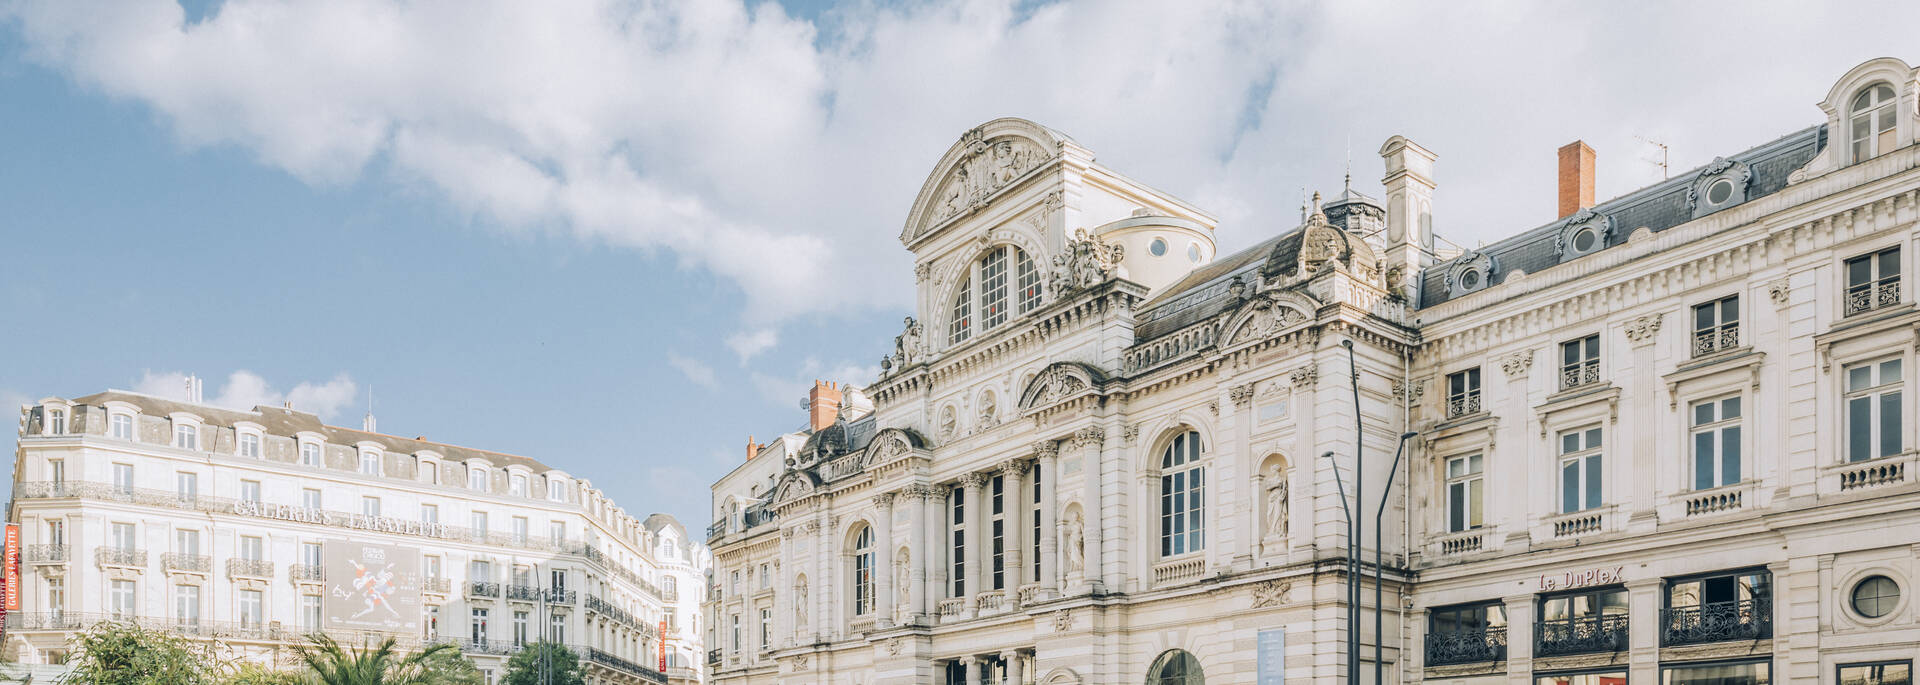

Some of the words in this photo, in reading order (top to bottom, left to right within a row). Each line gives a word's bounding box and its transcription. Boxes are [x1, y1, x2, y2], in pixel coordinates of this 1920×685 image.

[233, 500, 331, 525] GALERIES
[347, 512, 449, 539] LAFAYETTE
[8, 529, 17, 571] LAFAYETTE
[8, 571, 17, 607] GALERIES
[1540, 574, 1556, 591] Le
